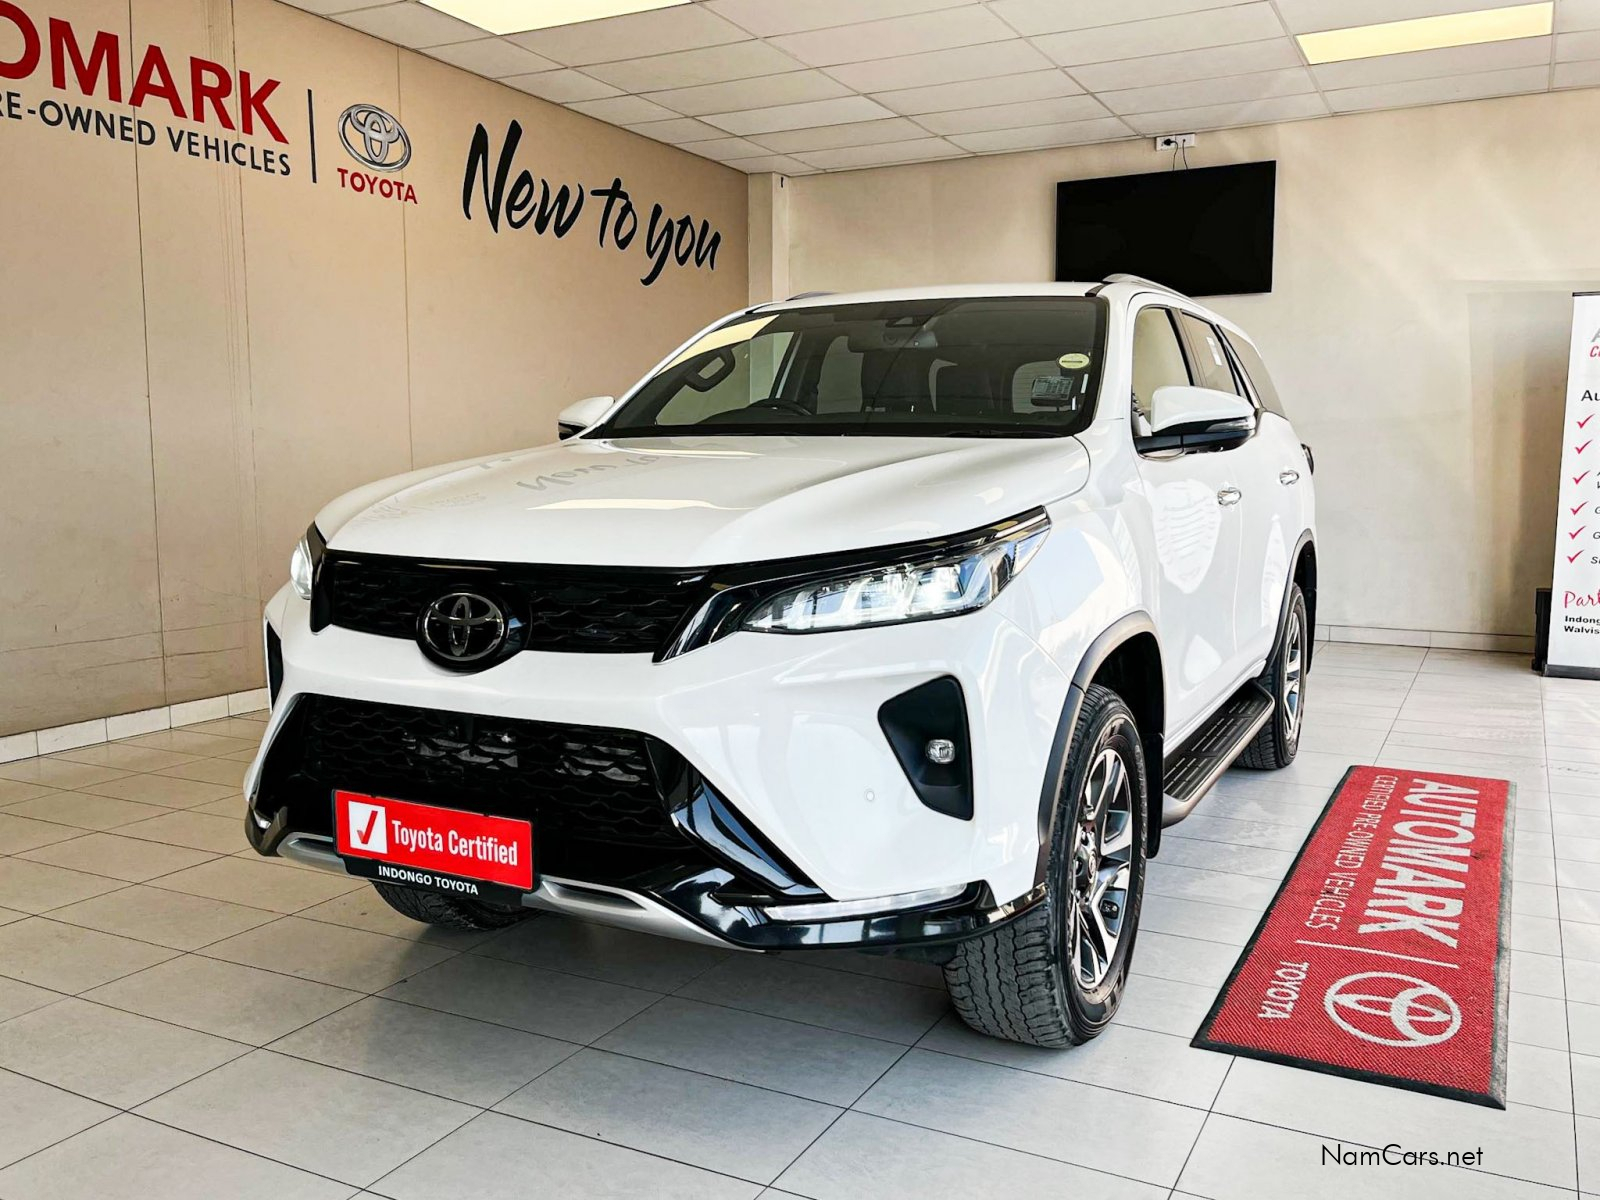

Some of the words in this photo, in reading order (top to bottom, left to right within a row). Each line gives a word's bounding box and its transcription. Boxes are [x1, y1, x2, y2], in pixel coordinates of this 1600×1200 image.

[0, 90, 156, 146] E-OWNED
[166, 126, 291, 176] VEHICLES
[337, 167, 418, 205] TOYOTA
[462, 119, 584, 238] New
[590, 177, 638, 250] to
[640, 203, 721, 286] you
[1362, 774, 1399, 811] CERTIFIED
[391, 820, 443, 852] Toyota
[448, 830, 518, 866] Certified
[1333, 812, 1382, 869] PRE-OWNED
[1357, 778, 1479, 949] AUTOMARK
[378, 865, 432, 885] INDONGO
[434, 876, 479, 896] TOYOTA
[1305, 871, 1358, 931] VEHICLES
[1257, 960, 1311, 1019] TOYOTA
